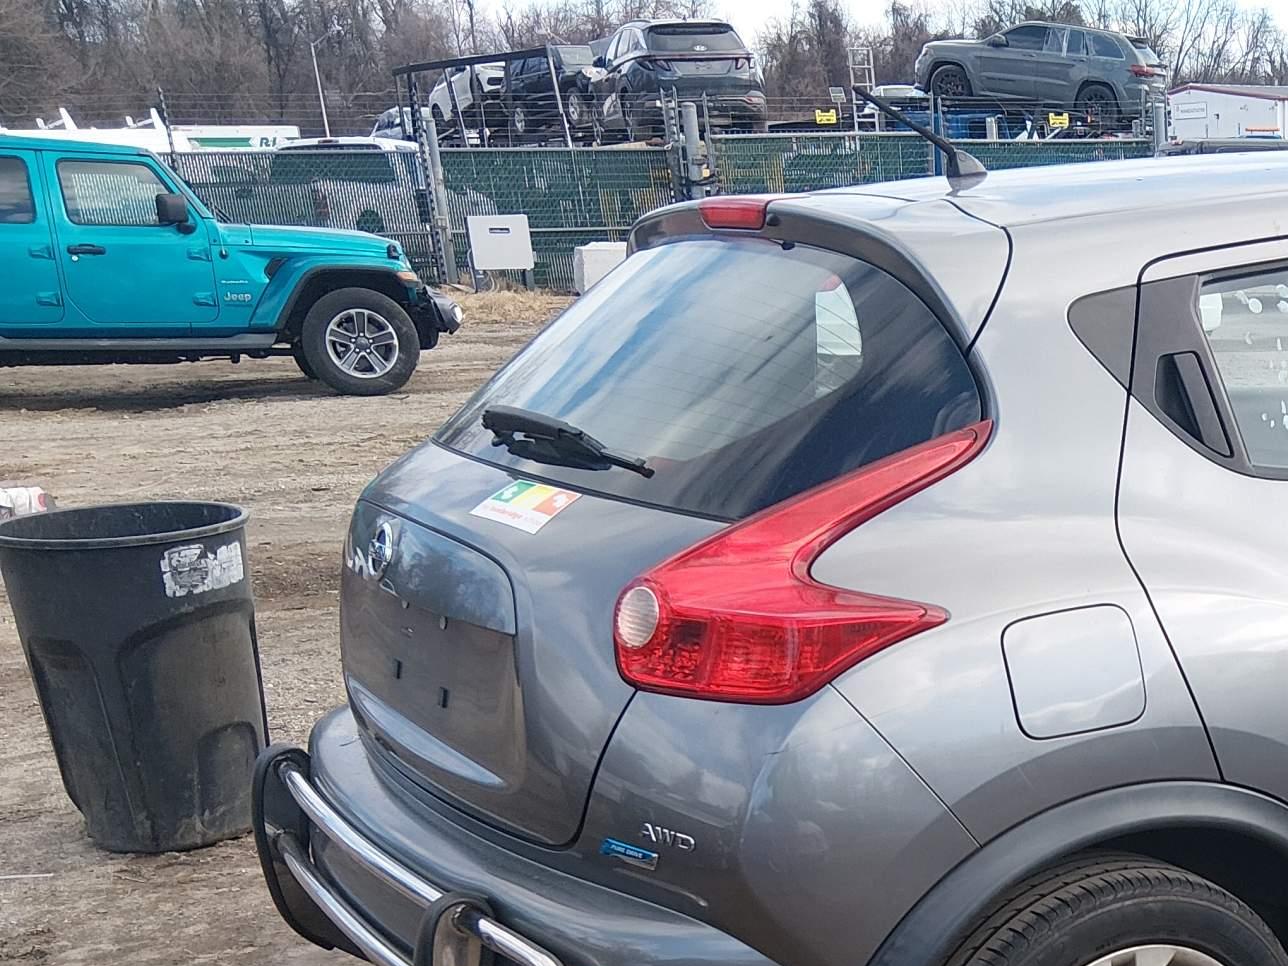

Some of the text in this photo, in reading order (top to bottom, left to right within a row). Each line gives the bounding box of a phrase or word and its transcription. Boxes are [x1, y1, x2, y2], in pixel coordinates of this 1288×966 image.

[224, 291, 252, 302] Jeep
[641, 823, 695, 852] AWD
[610, 844, 643, 859] PURE DRIVE
